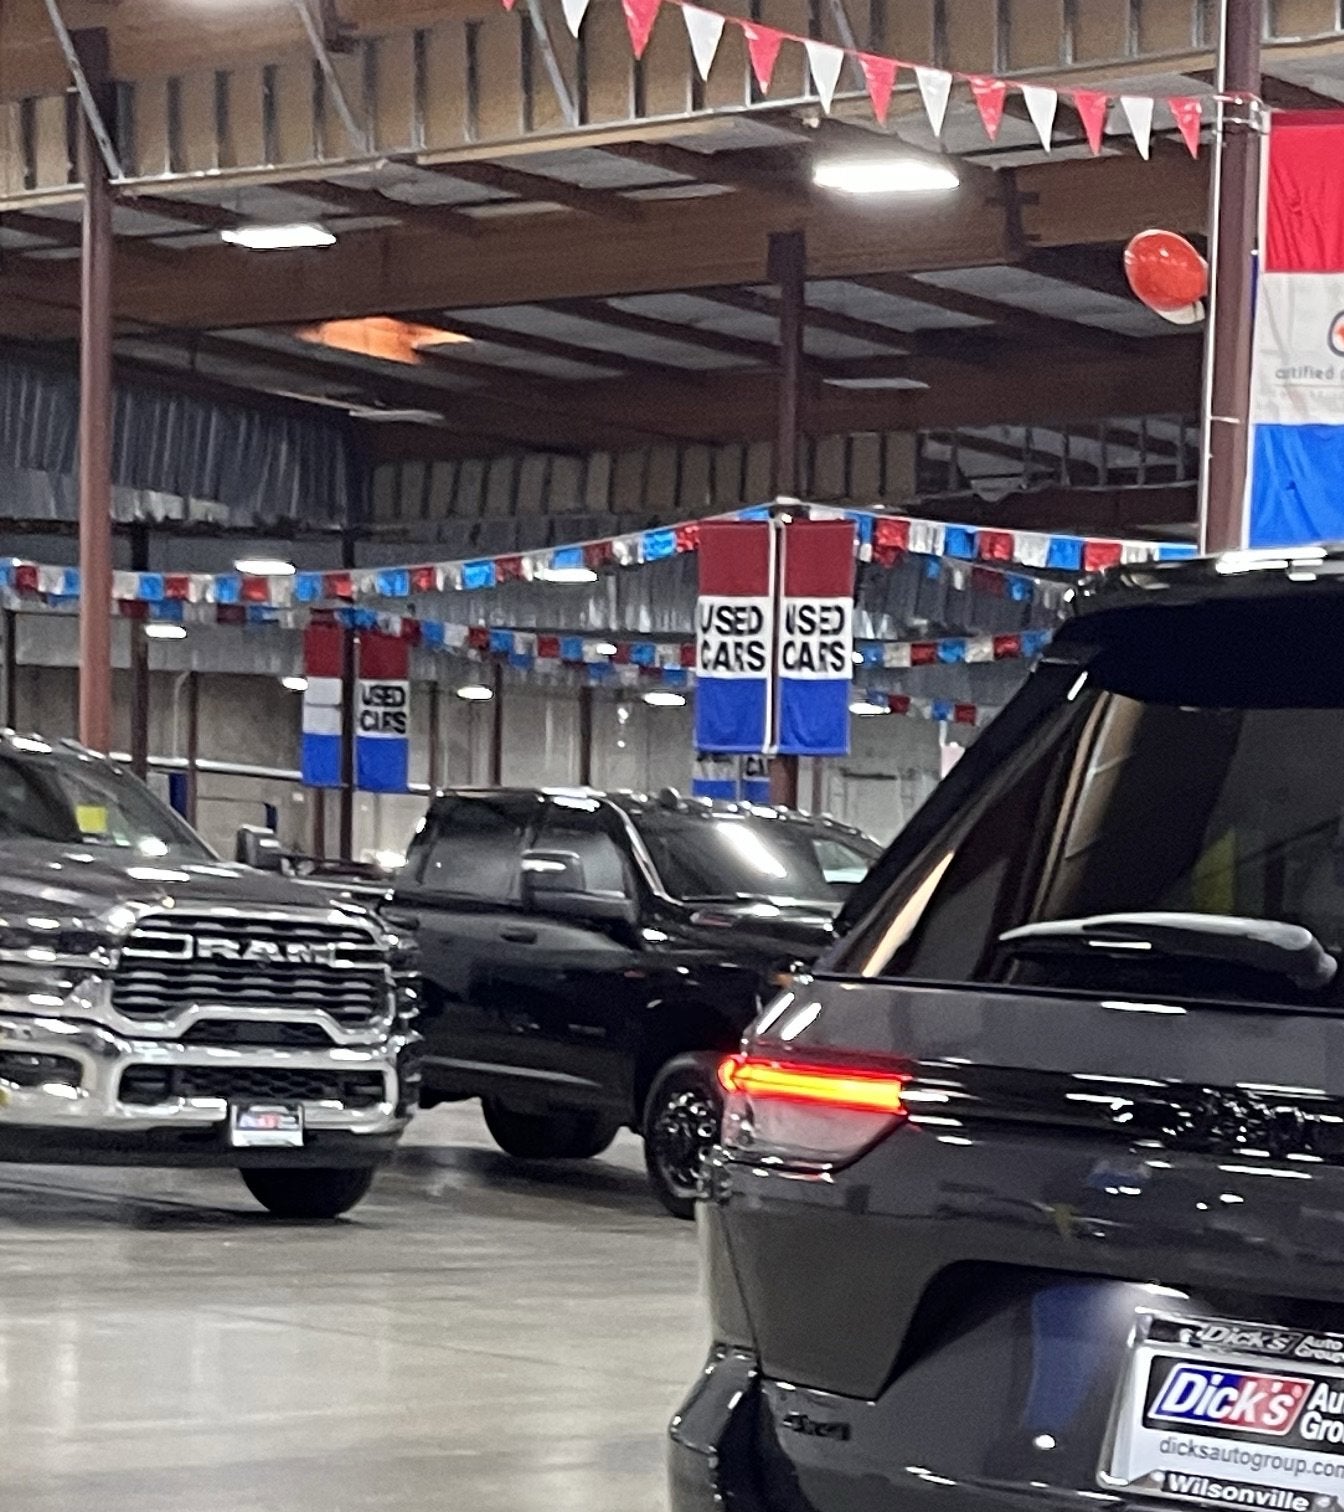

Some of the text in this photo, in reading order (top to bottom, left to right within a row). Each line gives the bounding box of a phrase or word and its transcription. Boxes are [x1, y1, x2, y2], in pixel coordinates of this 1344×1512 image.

[701, 604, 763, 635] USED
[785, 604, 845, 635] USED
[701, 640, 765, 671] CARS
[783, 640, 845, 671] CARS
[197, 937, 334, 966] RAM
[1201, 1325, 1292, 1351] Dick's
[1304, 1336, 1344, 1350] Auto
[1160, 1371, 1296, 1426] Dick's
[1168, 1472, 1311, 1512] Wilsonville
